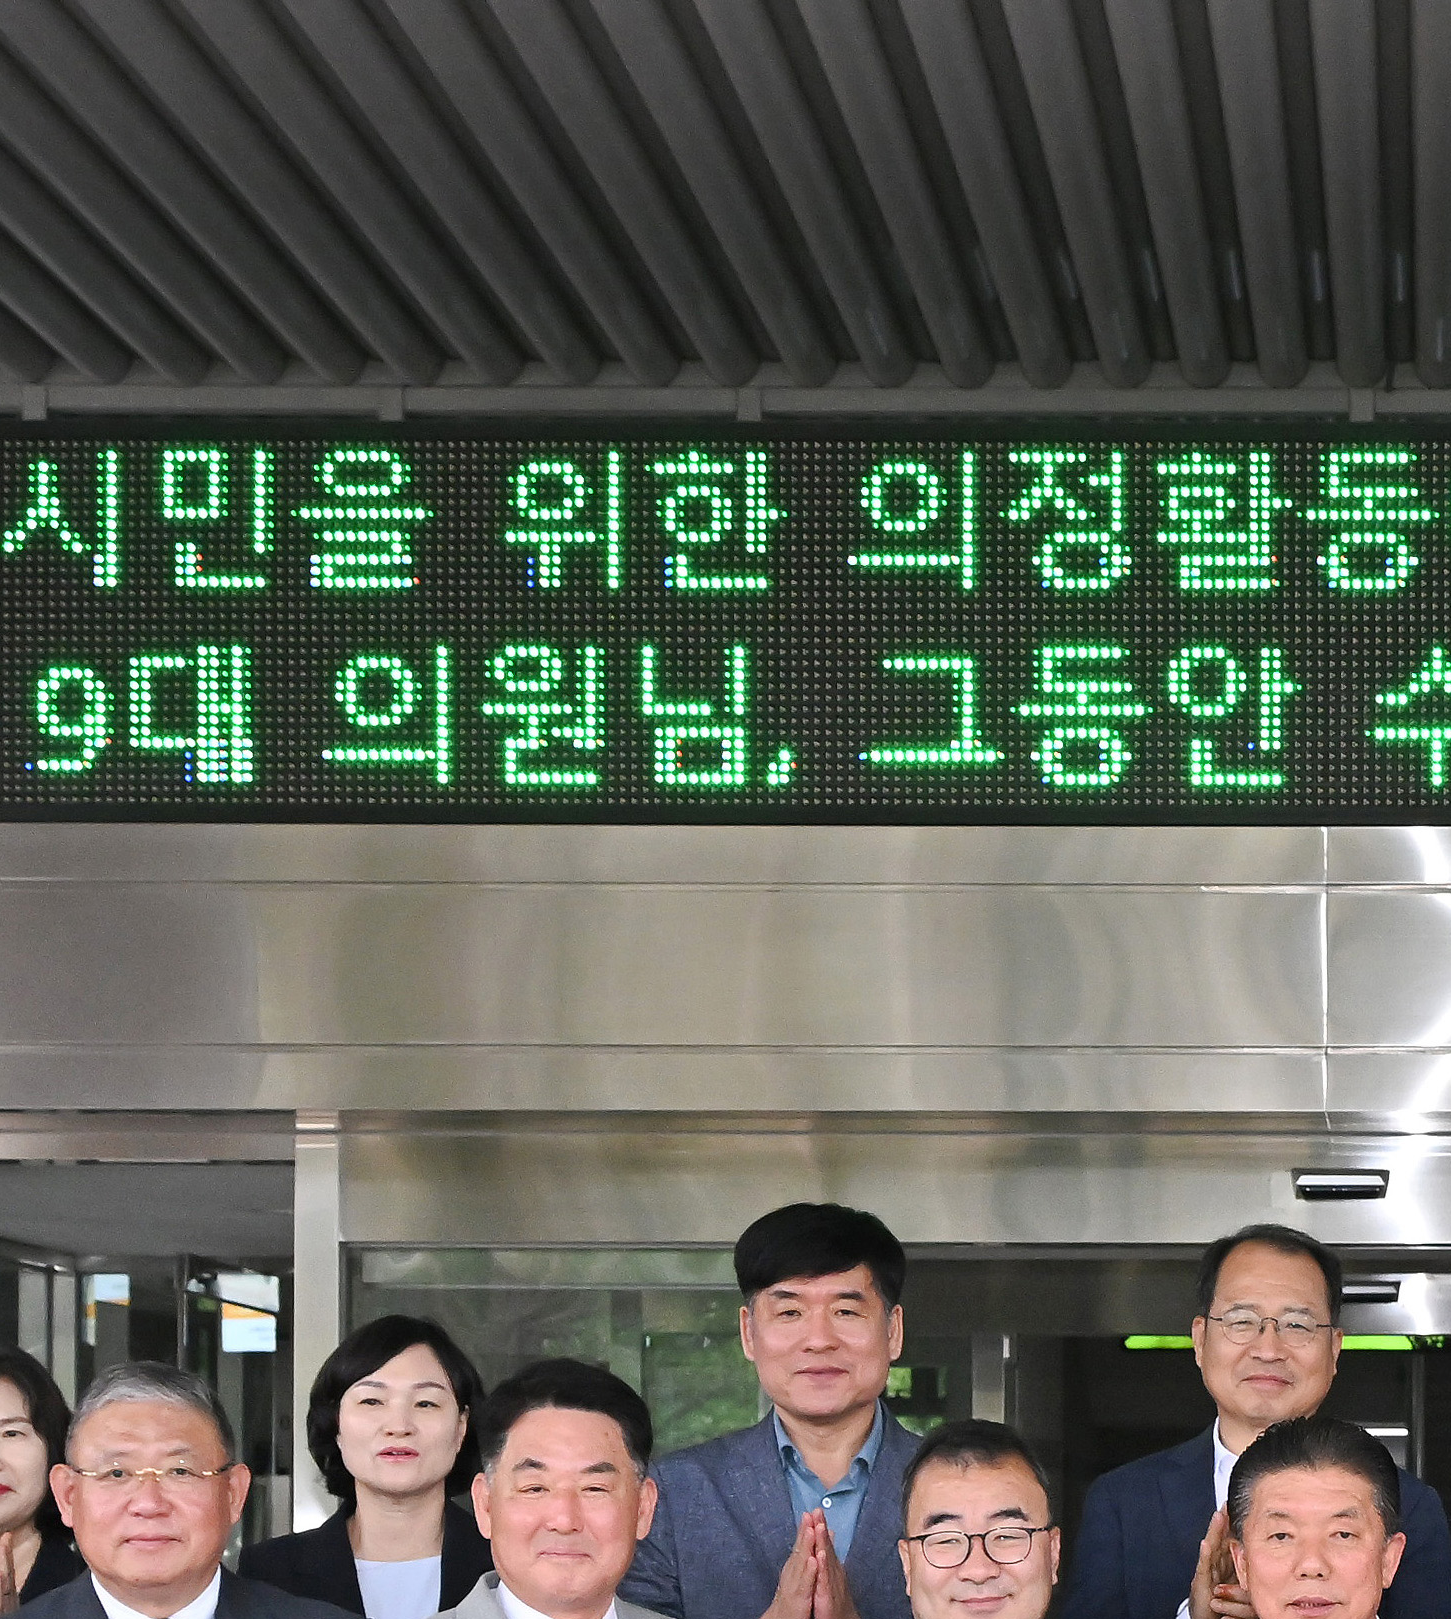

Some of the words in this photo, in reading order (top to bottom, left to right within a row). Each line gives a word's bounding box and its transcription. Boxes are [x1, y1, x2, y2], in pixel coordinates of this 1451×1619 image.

[503, 448, 789, 594] 위한
[24, 643, 254, 784] 9대
[320, 644, 798, 790] 의원님,
[860, 642, 1303, 791] 그동안
